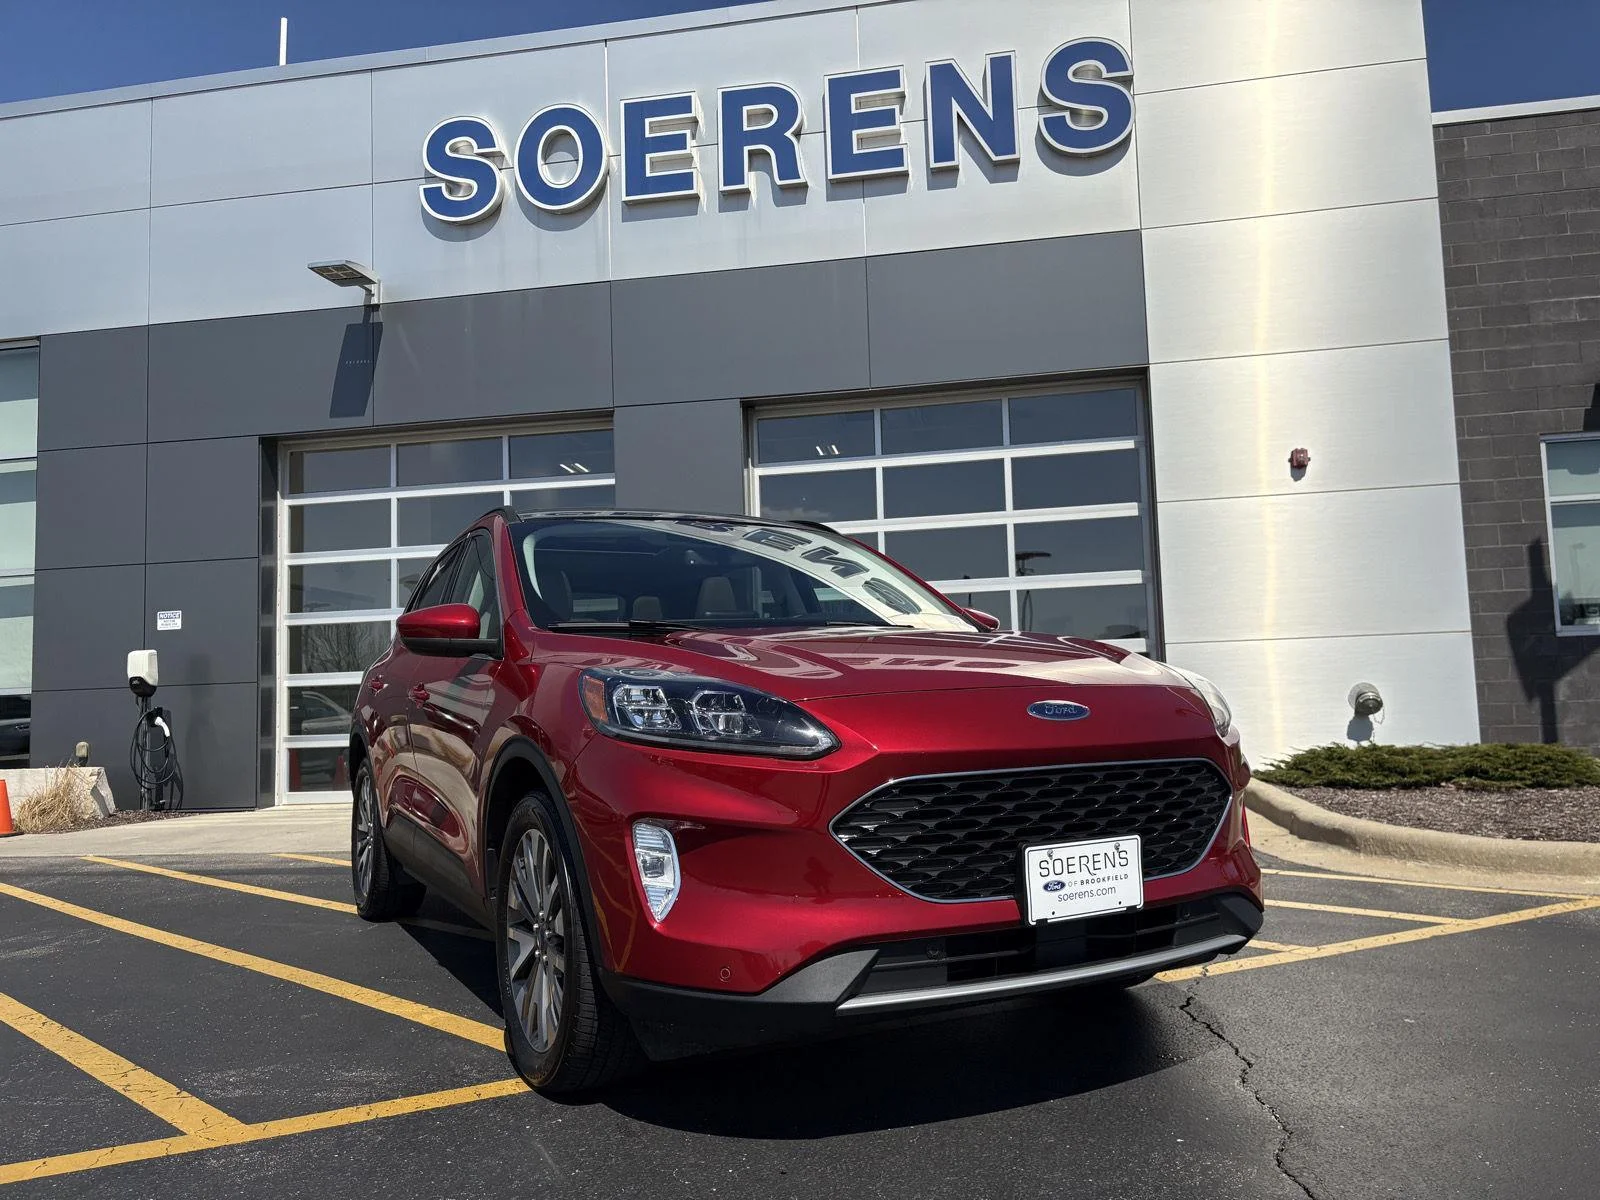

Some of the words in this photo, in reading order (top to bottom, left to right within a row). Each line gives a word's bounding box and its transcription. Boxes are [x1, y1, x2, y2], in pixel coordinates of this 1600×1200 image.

[419, 37, 1135, 223] SOERENS
[1039, 850, 1129, 878] SOERENS
[1046, 881, 1062, 891] Ford
[1080, 873, 1129, 886] BROOKFIELD
[1057, 886, 1117, 902] soerens.com
